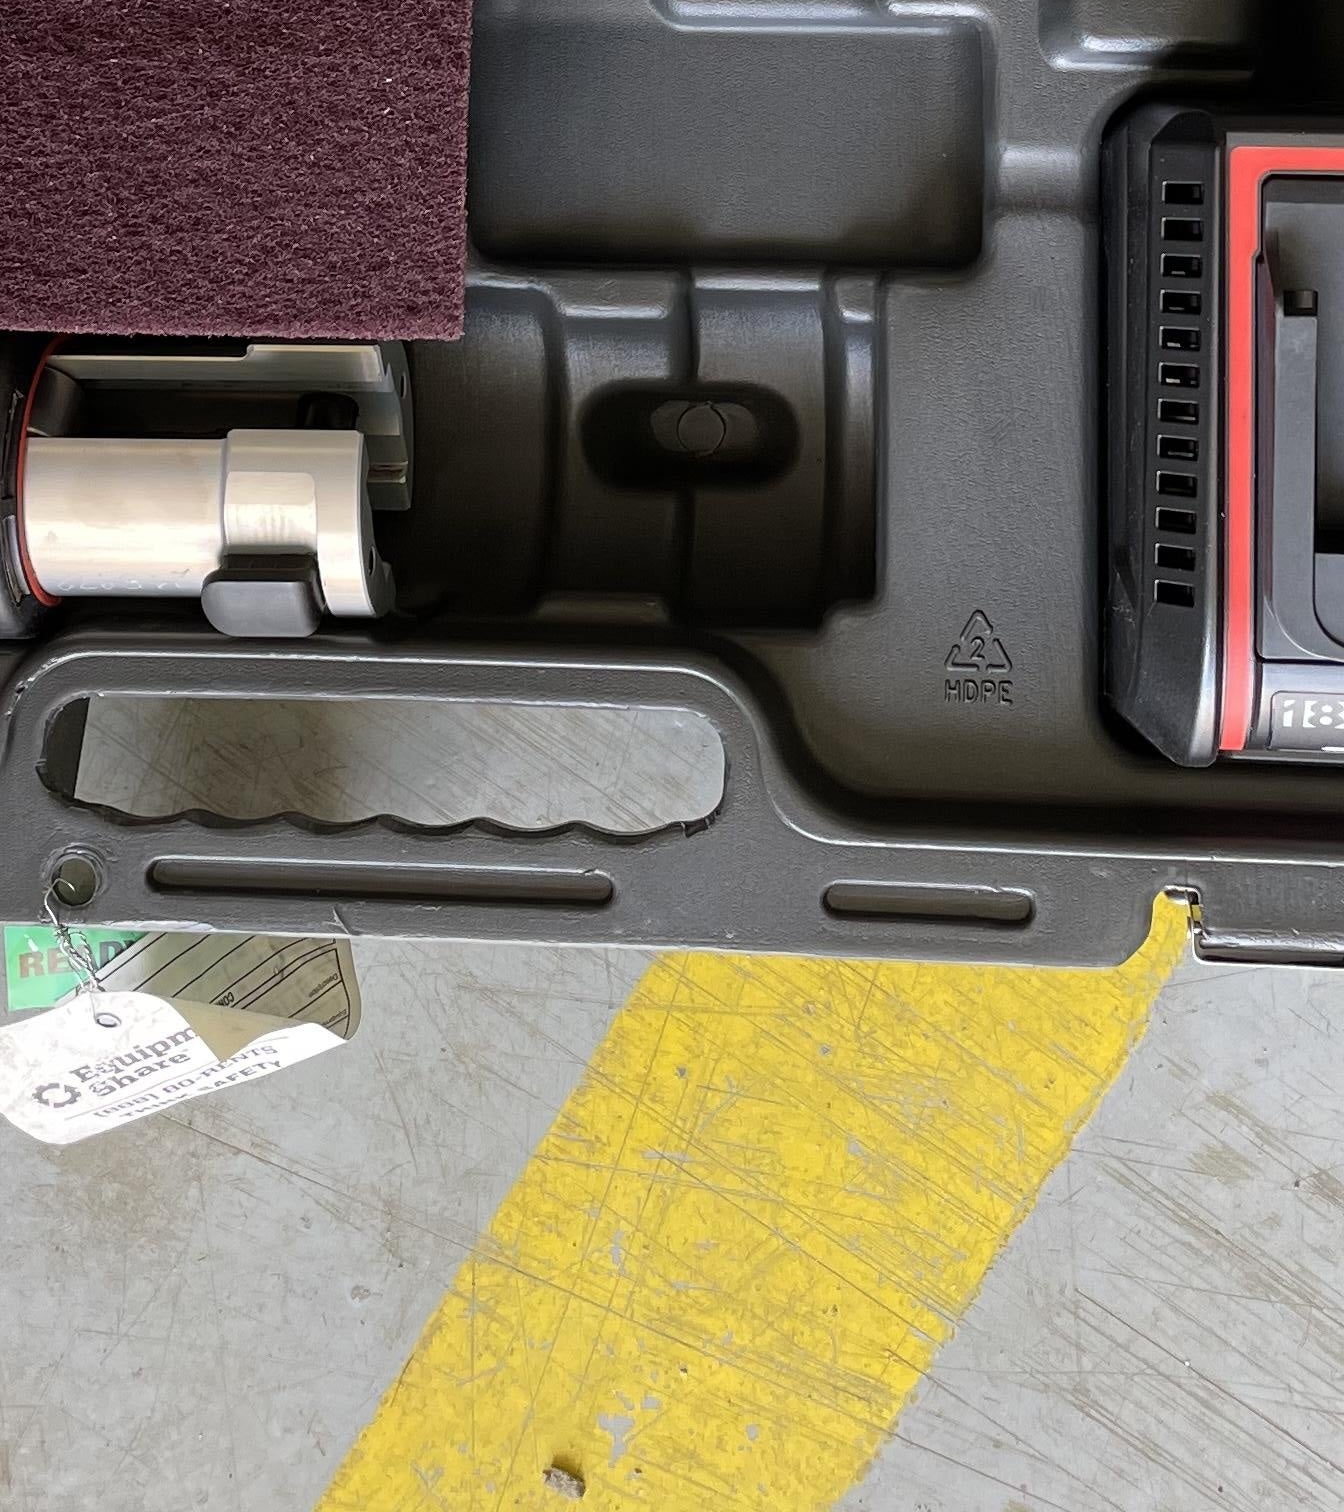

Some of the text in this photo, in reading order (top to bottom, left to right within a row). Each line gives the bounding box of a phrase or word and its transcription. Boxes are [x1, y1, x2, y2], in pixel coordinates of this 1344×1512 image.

[944, 679, 1014, 705] HDPE
[69, 1027, 199, 1083] Equipm
[89, 1053, 191, 1097] Share
